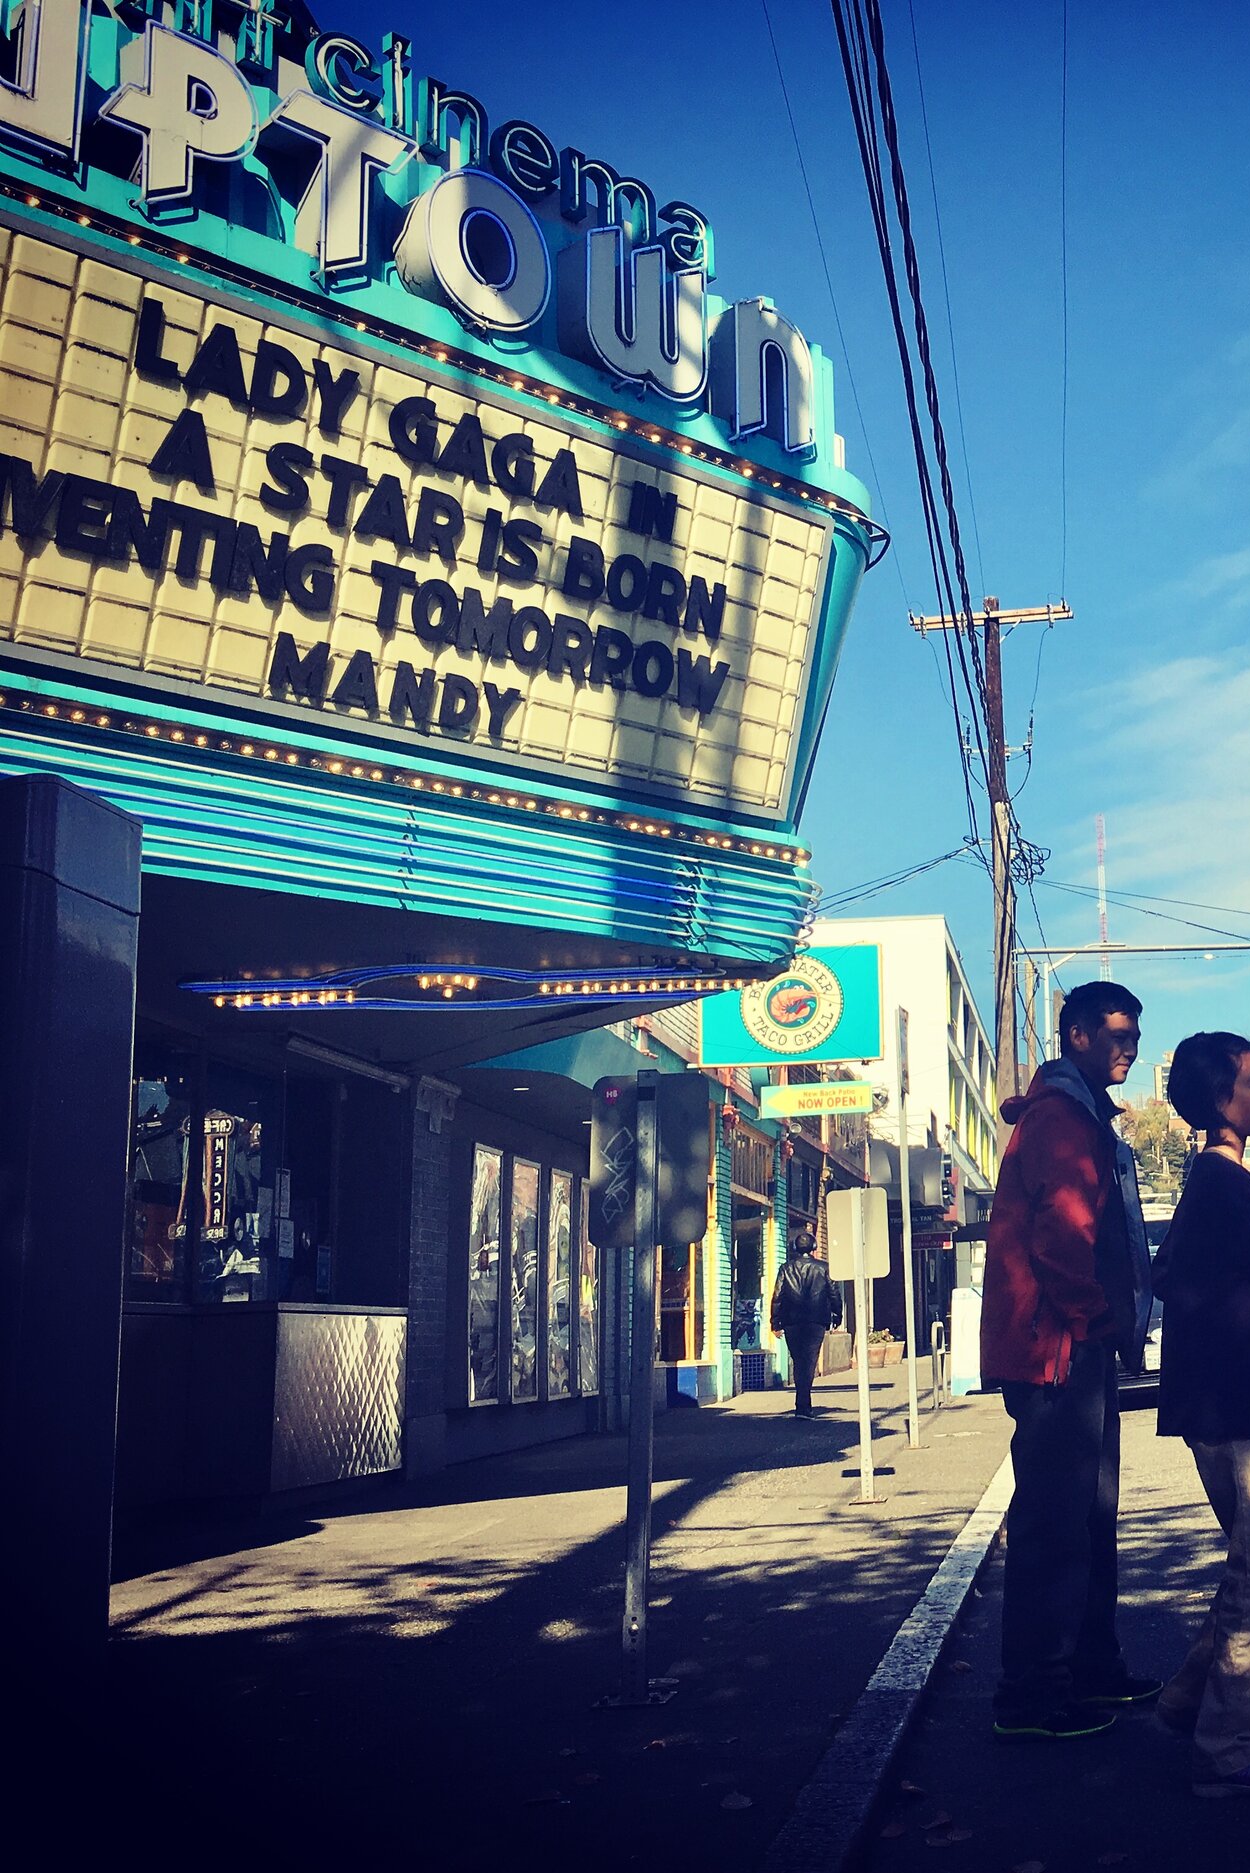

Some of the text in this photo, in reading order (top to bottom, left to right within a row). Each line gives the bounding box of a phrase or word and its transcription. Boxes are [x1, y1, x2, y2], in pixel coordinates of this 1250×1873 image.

[305, 31, 716, 280] cinema
[134, 296, 678, 543] LADY GAGA IN
[149, 409, 727, 640] A STAR IS BORN
[269, 632, 522, 740] MANDY
[371, 560, 730, 715] TOMORROW
[753, 1012, 834, 1046] TACO GRILL
[819, 1089, 836, 1097] Back
[838, 1088, 856, 1096] Patio
[797, 1098, 823, 1110] NOW
[826, 1096, 857, 1108] OPEN
